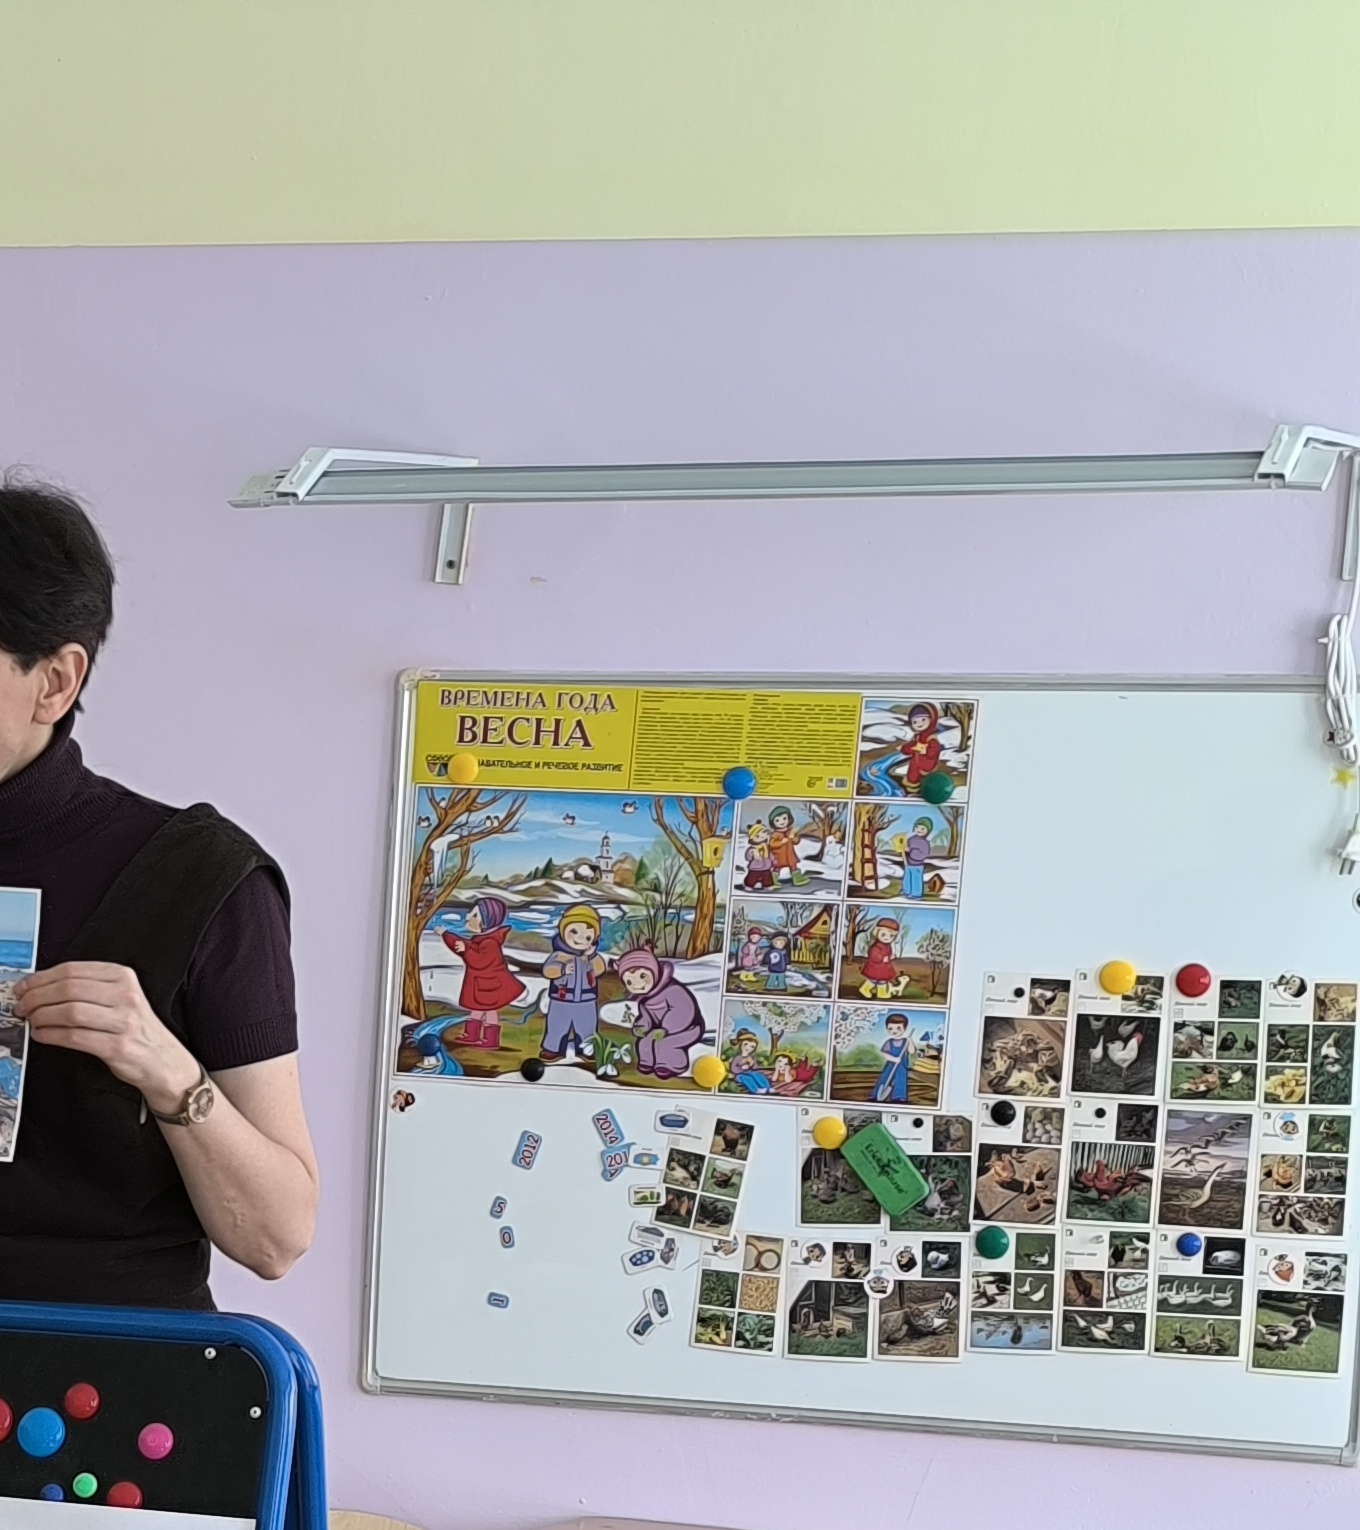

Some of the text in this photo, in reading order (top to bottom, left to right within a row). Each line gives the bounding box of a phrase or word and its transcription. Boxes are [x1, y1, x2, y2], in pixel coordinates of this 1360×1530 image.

[439, 687, 618, 715] ВРЕМЕНА ГОДА
[456, 713, 594, 750] ВЕСНА
[595, 1112, 620, 1145] 2014
[518, 1133, 540, 1167] 2012
